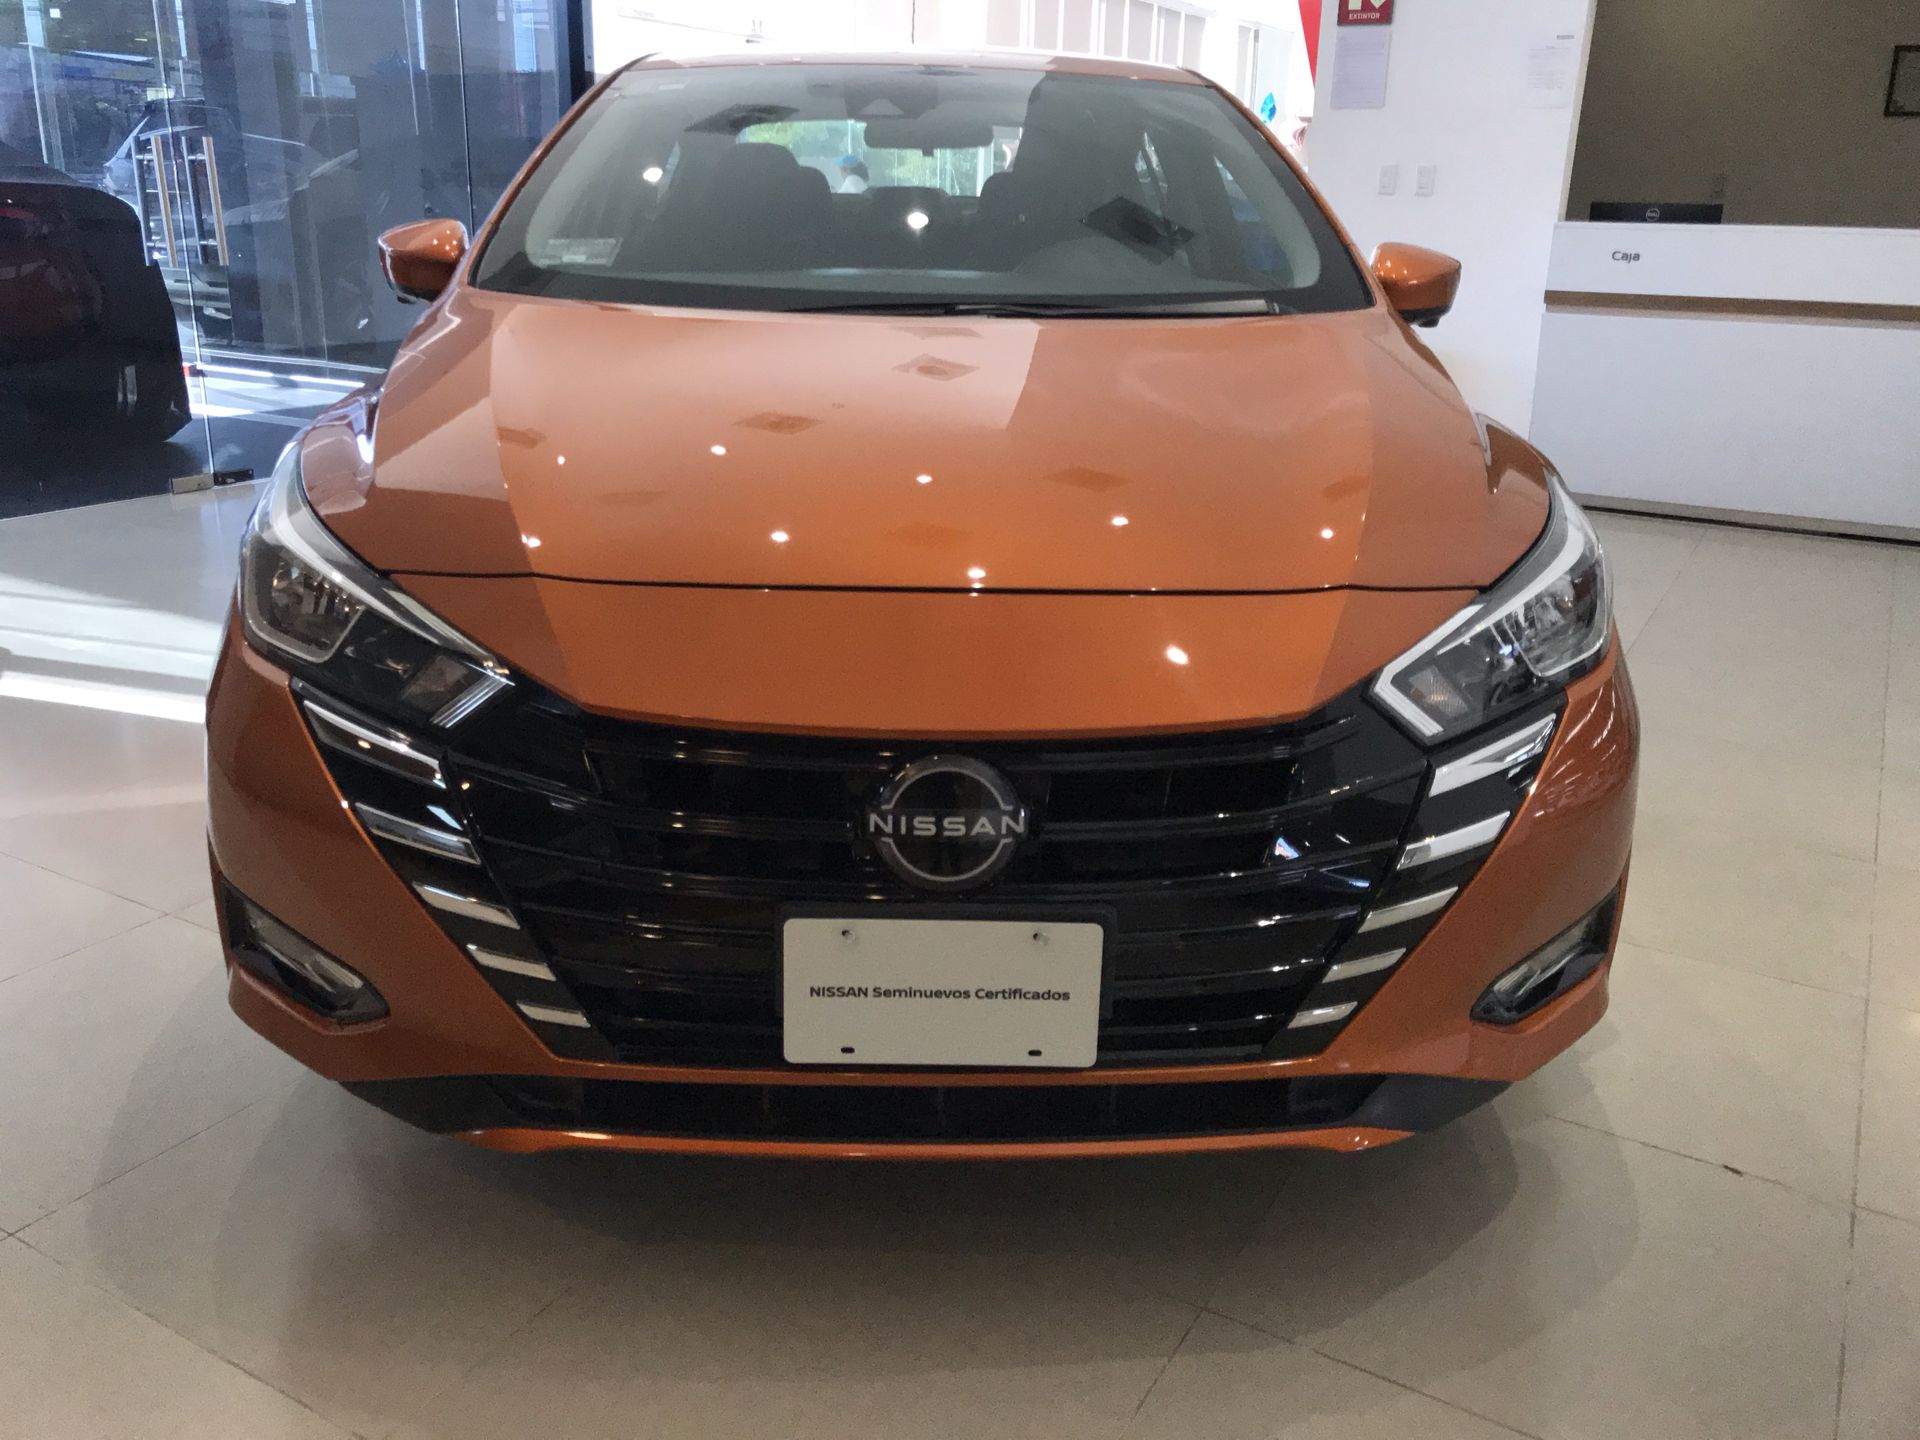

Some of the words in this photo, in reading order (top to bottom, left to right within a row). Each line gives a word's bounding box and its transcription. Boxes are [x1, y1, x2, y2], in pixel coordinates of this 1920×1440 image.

[1349, 12, 1380, 20] EXTINTOR
[1612, 250, 1640, 264] Caja
[869, 812, 1025, 836] NISSAN
[809, 986, 869, 998] NISSAN
[872, 986, 971, 999] Seminuevos
[974, 988, 1071, 1001] Certificados
